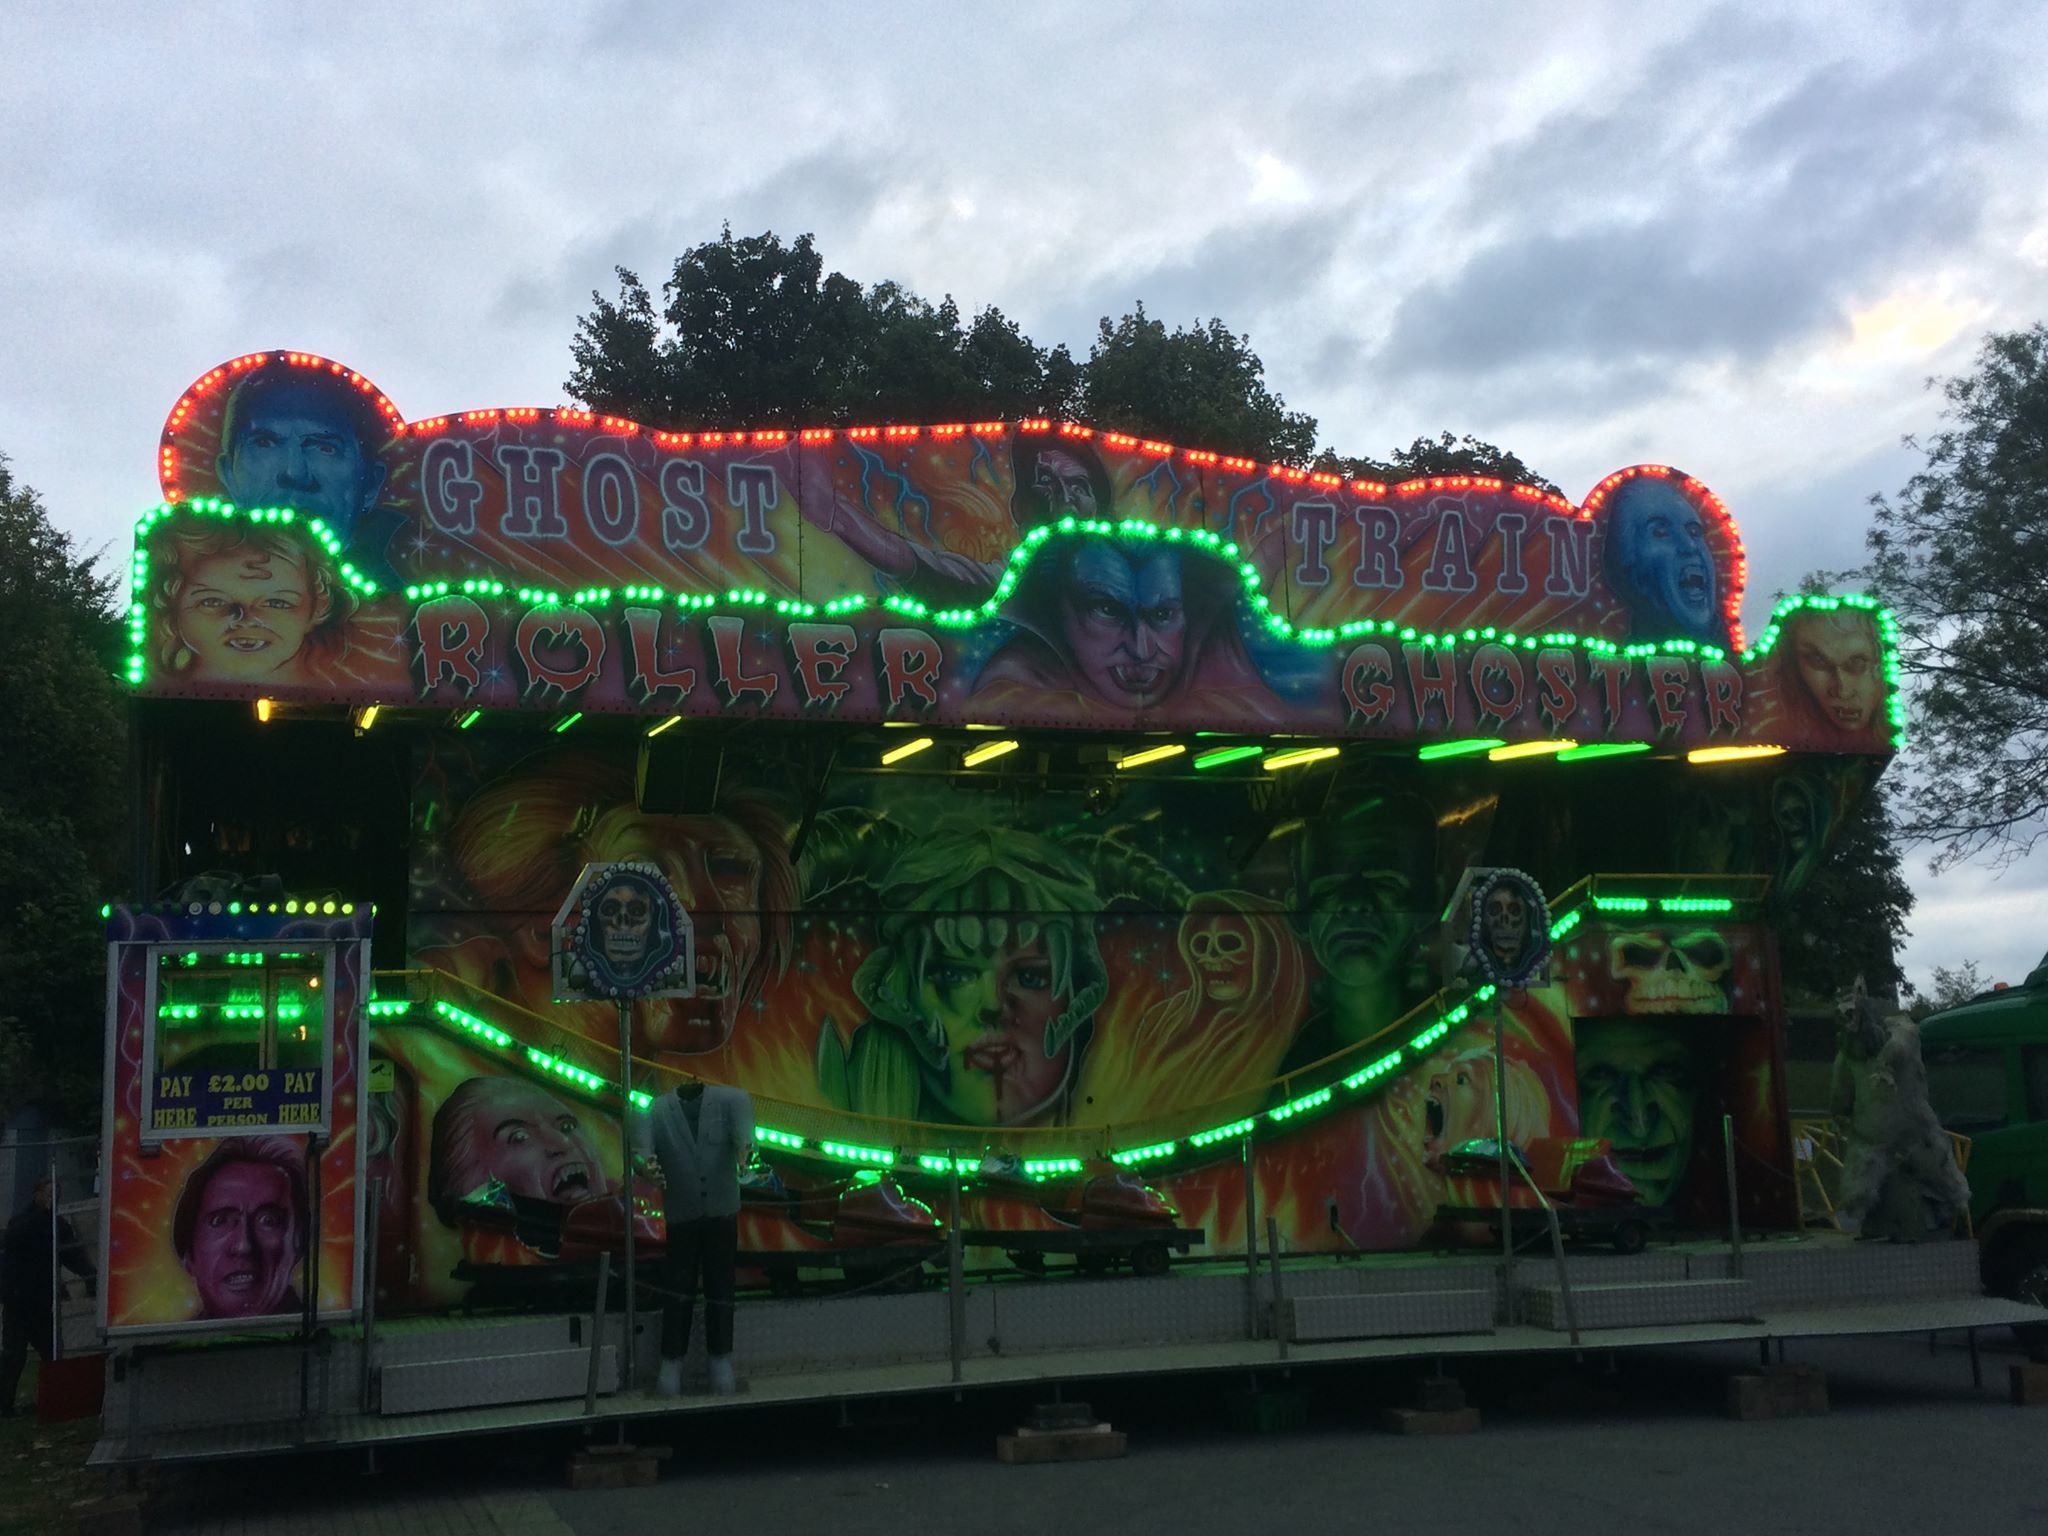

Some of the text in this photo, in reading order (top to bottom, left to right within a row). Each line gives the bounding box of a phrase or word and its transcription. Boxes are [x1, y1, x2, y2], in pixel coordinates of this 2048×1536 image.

[421, 439, 1596, 596] GHOST TRAIN
[412, 594, 1744, 737] ROLLER GHOSTER
[160, 1076, 193, 1098] PAY
[207, 1074, 269, 1093] £2.00
[284, 1071, 316, 1094] PAY
[223, 1097, 253, 1110] PER
[278, 1103, 320, 1124] HERE
[153, 1107, 198, 1129] HERE
[207, 1113, 269, 1127] PERSON
